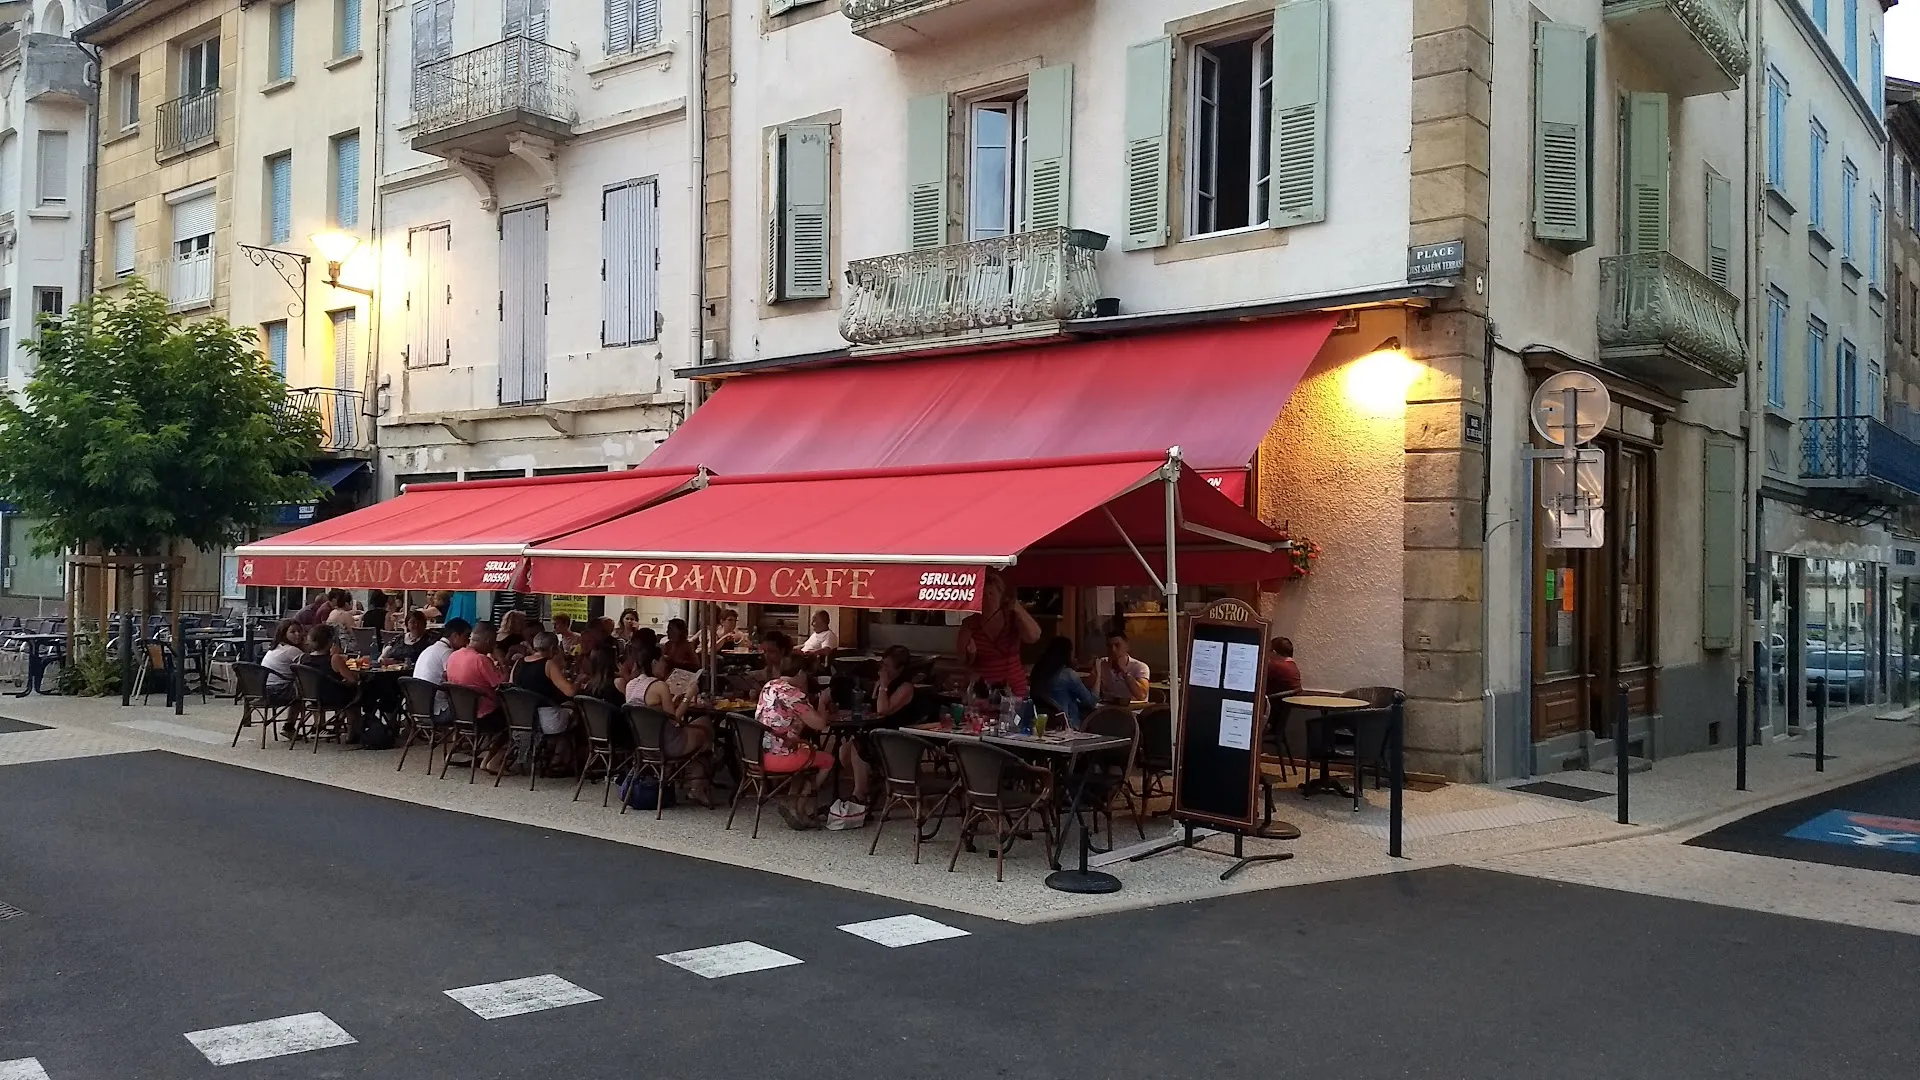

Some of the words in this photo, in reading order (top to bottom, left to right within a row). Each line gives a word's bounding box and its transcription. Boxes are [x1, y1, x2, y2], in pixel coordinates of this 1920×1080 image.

[1416, 246, 1455, 260] PLACE
[284, 560, 310, 581] LE
[315, 559, 393, 582] GRAND
[400, 559, 464, 584] CAFE
[919, 572, 977, 586] SERILLON
[578, 562, 623, 589] LE
[628, 563, 758, 594] GRAND
[769, 567, 876, 600] CAFE
[918, 587, 976, 602] BOISSONS
[1209, 603, 1249, 622] BISTROT
